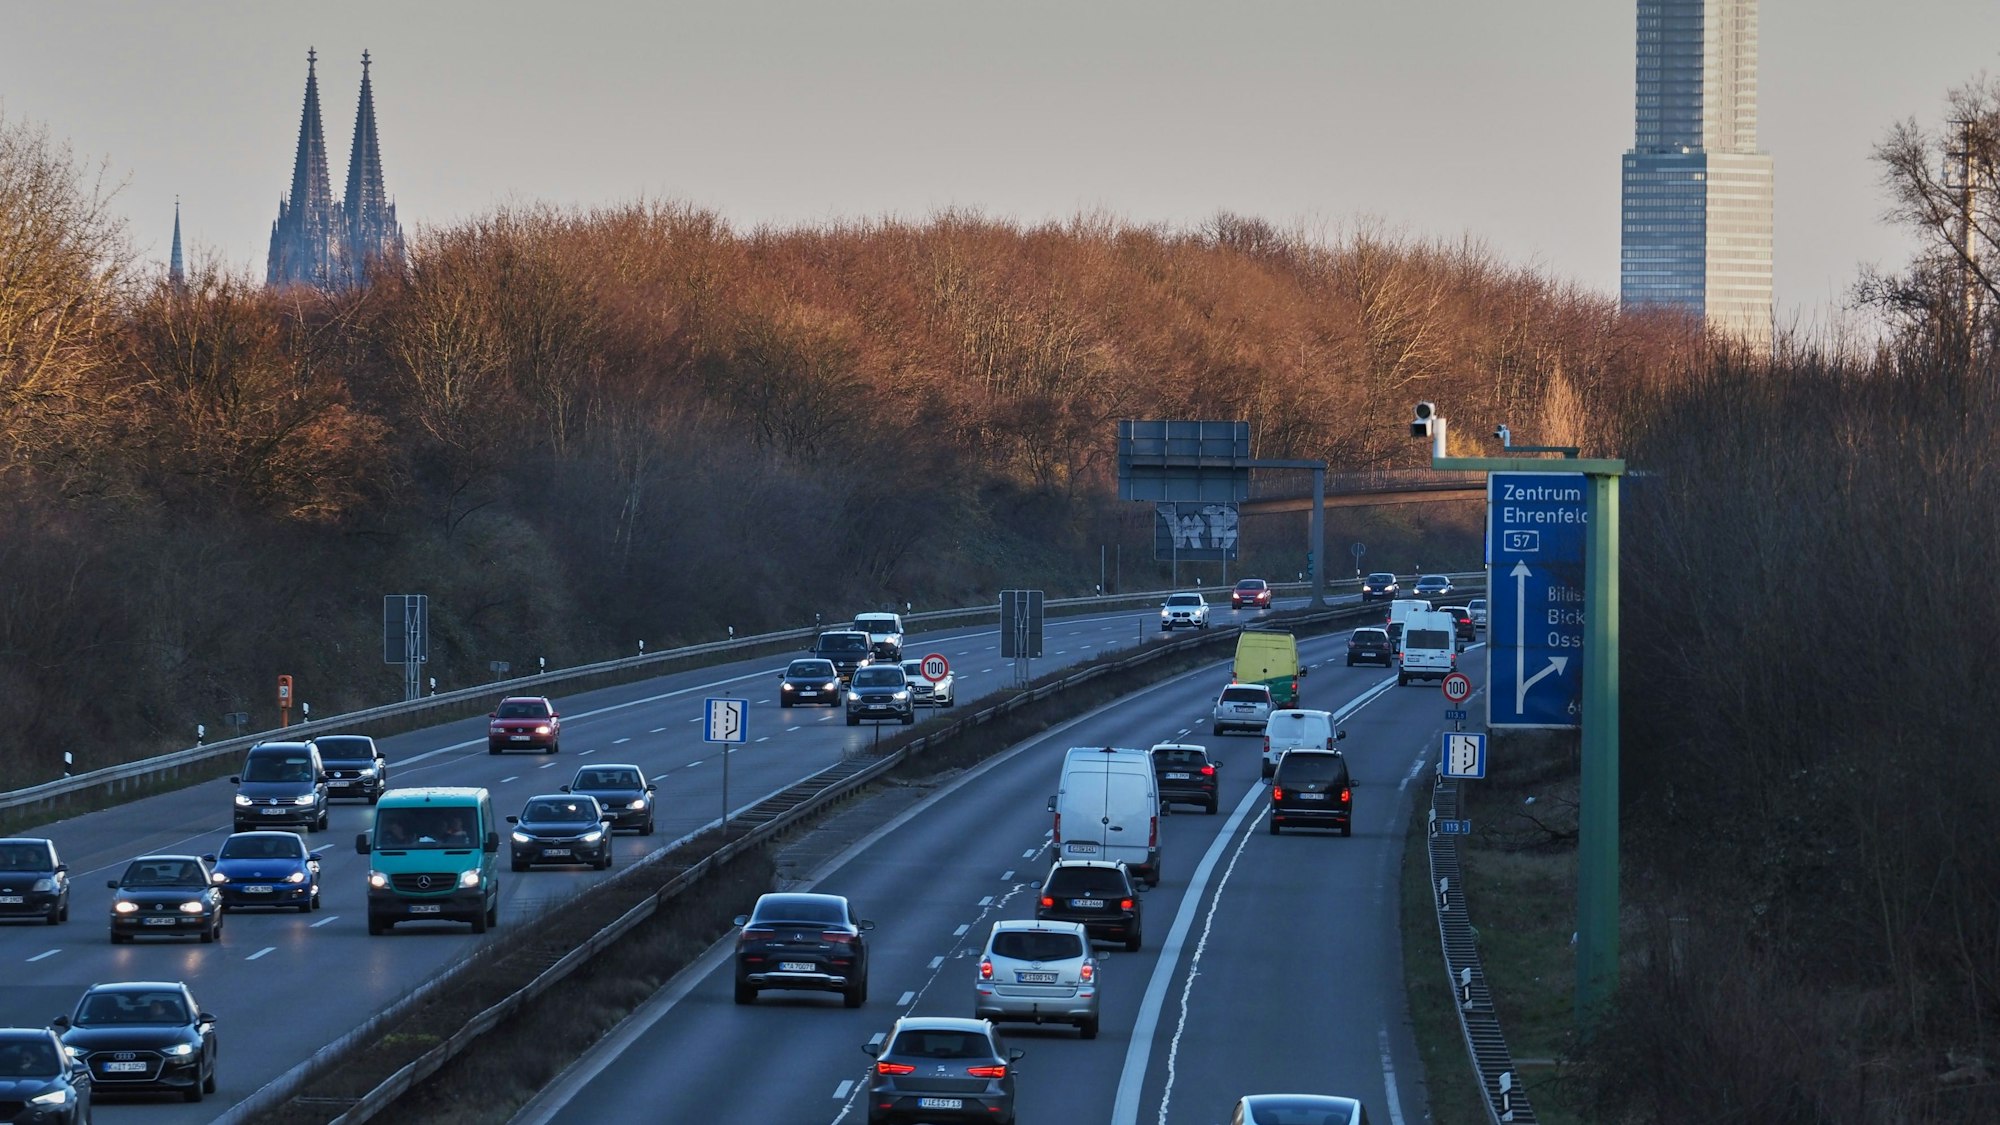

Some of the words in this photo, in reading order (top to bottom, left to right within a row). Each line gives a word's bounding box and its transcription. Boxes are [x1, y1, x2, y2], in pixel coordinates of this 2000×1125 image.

[1503, 484, 1581, 501] Zentrum
[1513, 534, 1530, 548] 57
[1547, 631, 1585, 648] Oss
[926, 661, 943, 675] 100
[1448, 681, 1465, 695] 100
